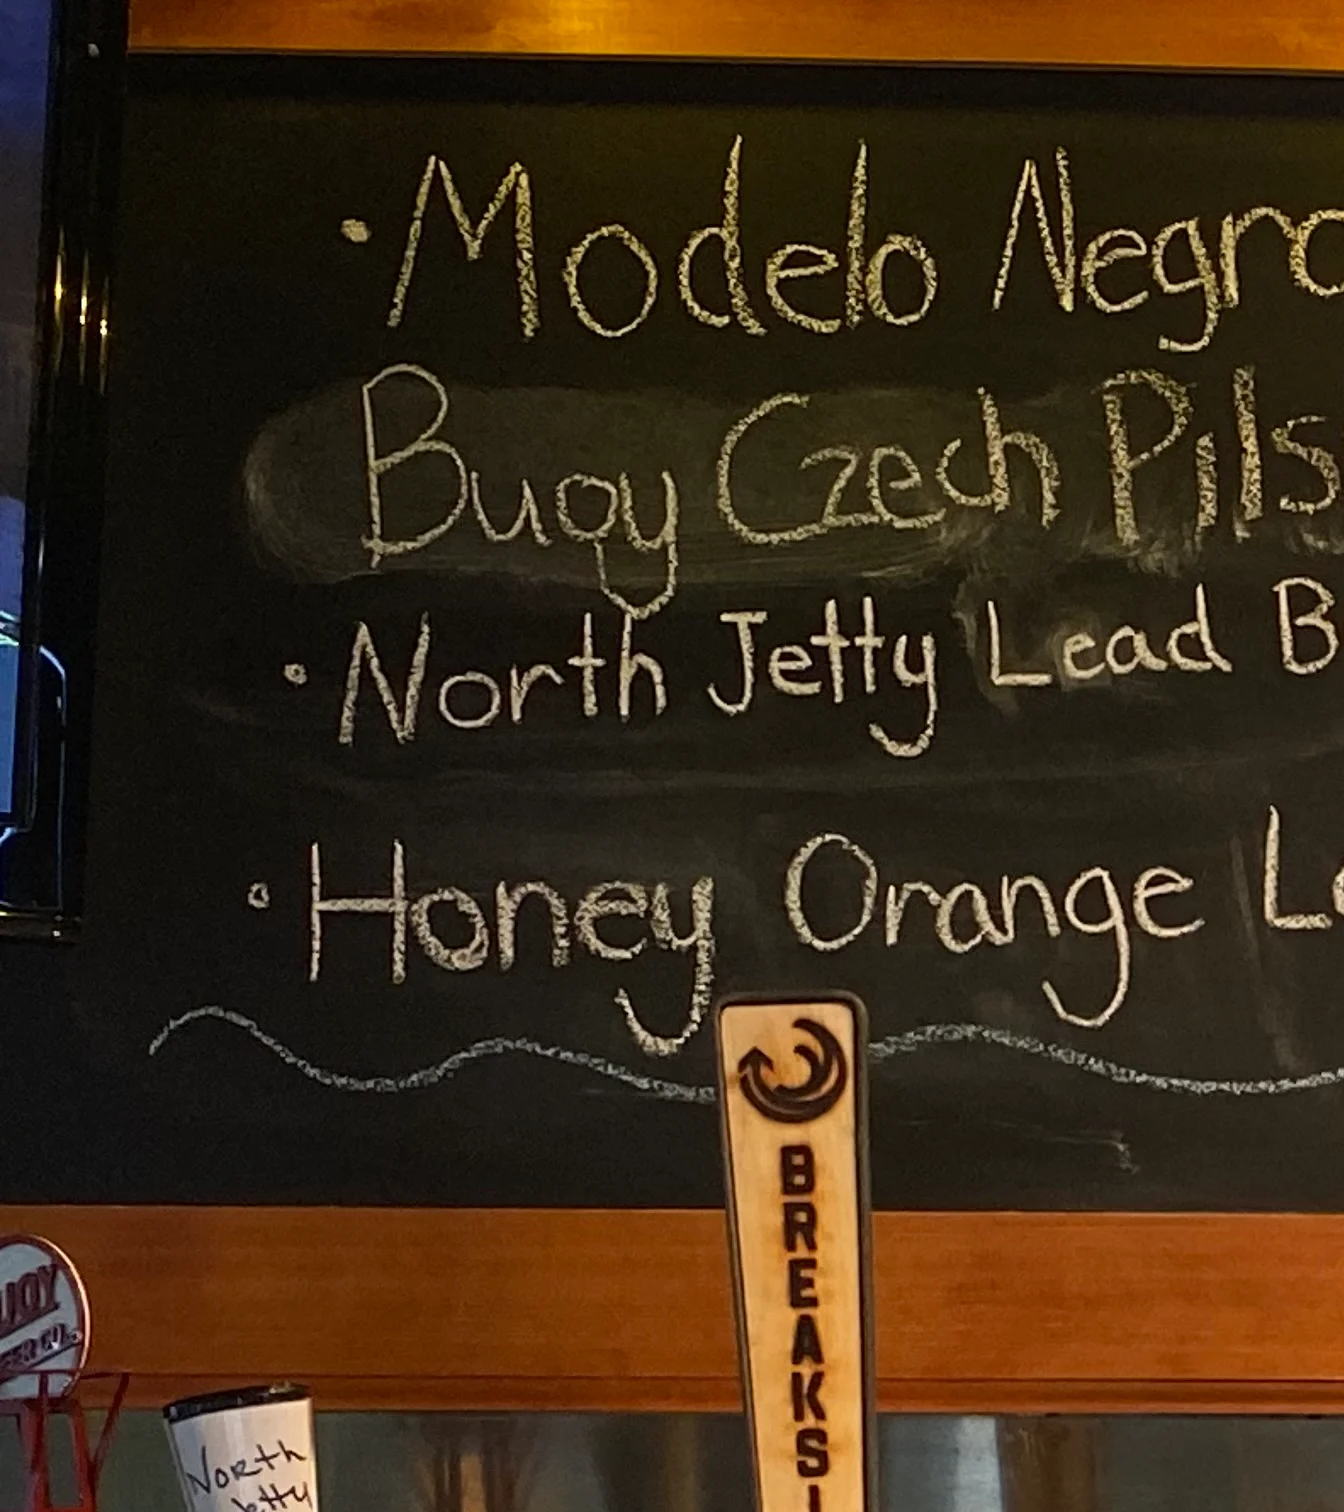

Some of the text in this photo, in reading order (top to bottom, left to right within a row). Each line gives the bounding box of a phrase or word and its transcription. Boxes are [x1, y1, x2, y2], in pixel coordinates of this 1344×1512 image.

[389, 135, 938, 336] Modelo
[362, 363, 680, 618] Buoy
[717, 388, 1061, 545] Czech
[338, 611, 667, 746] North
[707, 594, 938, 757] Jetty
[986, 585, 1234, 688] Lead
[307, 836, 716, 1055] Honey
[783, 833, 1204, 1030] Orange
